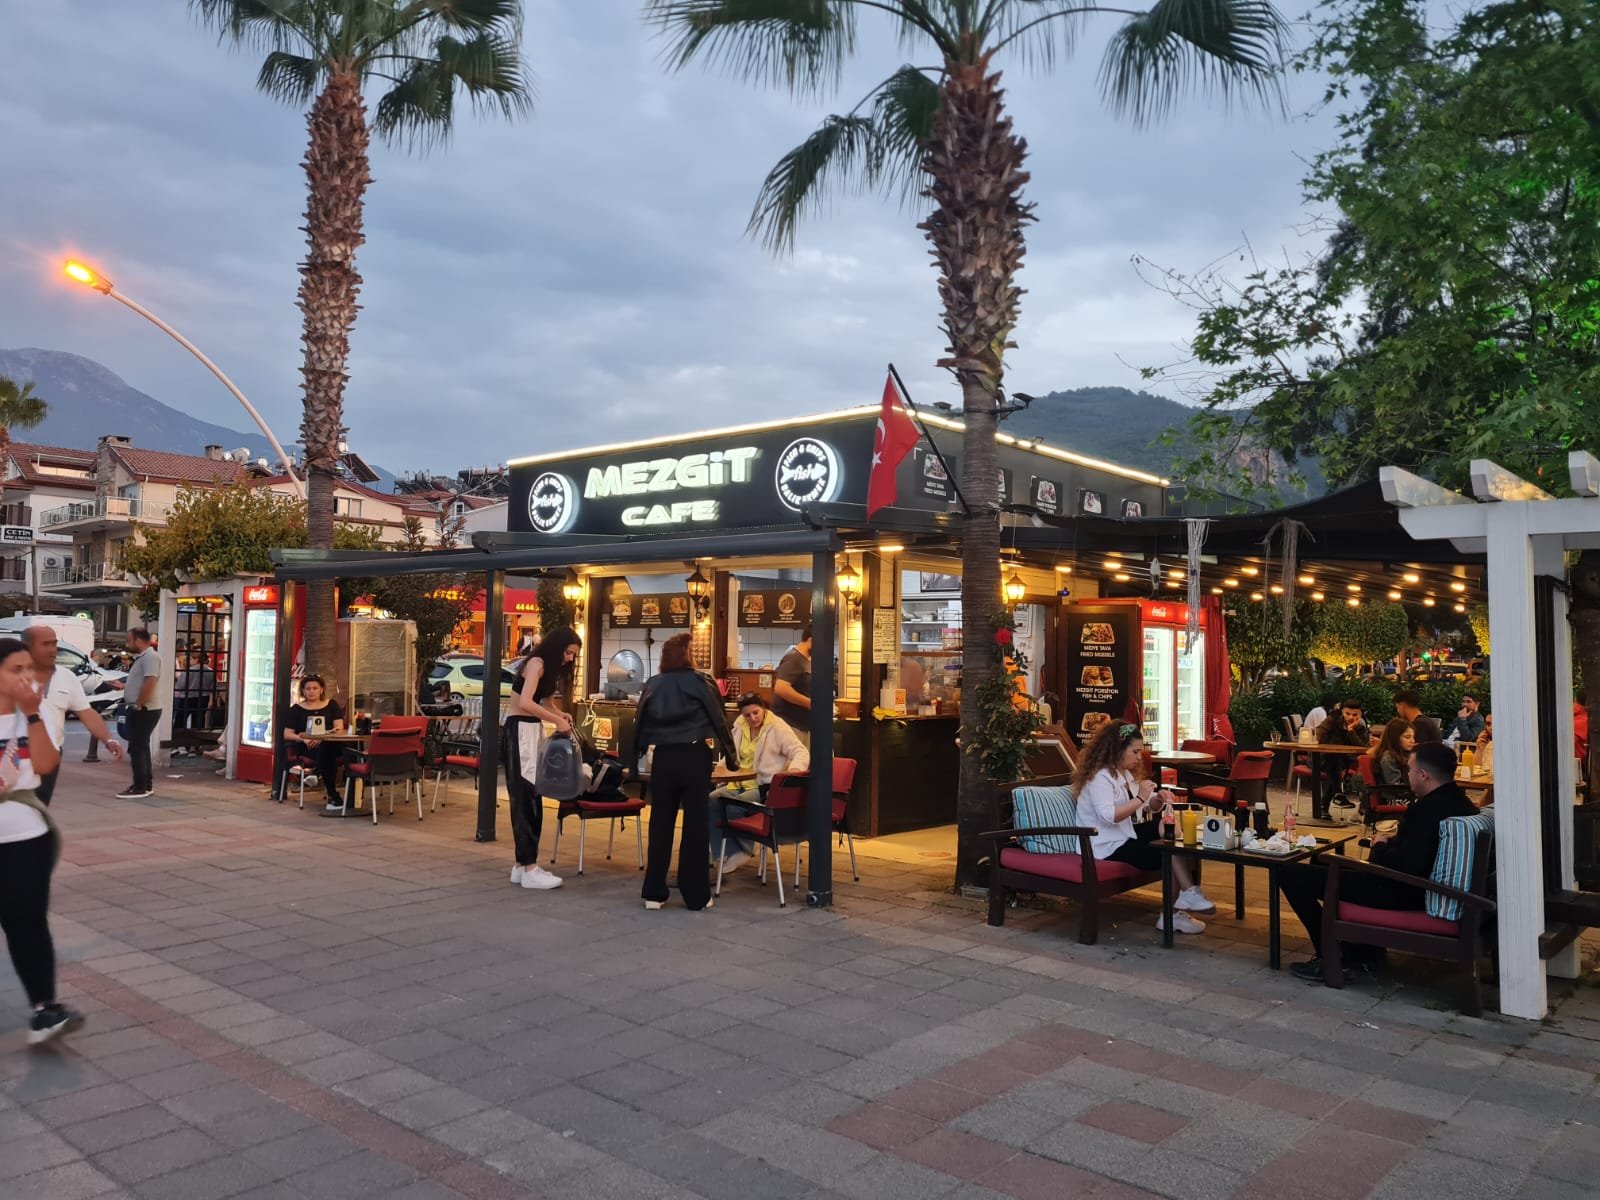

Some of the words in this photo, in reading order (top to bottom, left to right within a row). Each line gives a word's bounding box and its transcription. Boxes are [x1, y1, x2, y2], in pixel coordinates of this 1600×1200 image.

[805, 443, 826, 462] CHIPS
[793, 463, 816, 481] fish
[621, 500, 719, 527] CAFE
